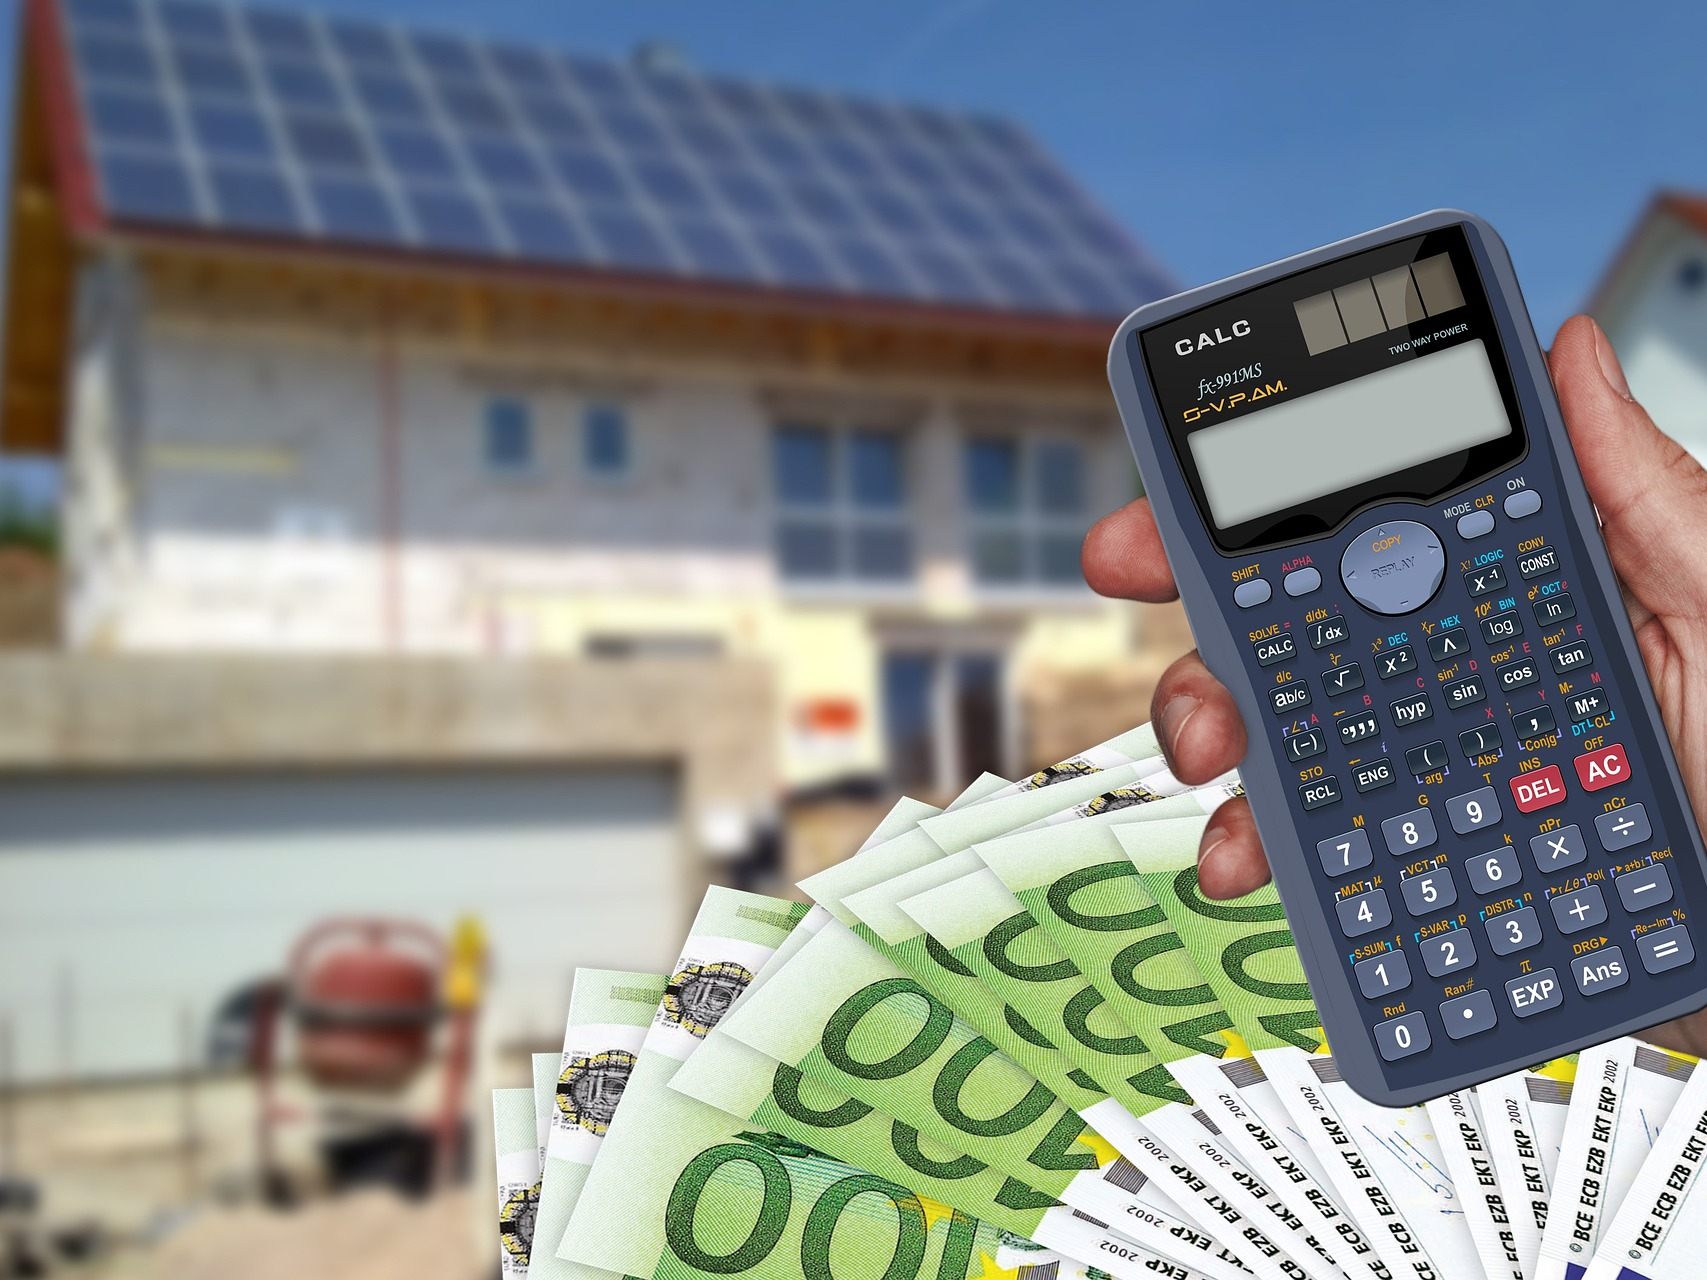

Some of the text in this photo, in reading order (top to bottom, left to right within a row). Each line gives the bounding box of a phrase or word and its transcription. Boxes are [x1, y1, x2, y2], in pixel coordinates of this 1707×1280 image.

[1175, 319, 1251, 356] CALC
[1389, 323, 1468, 356] TWO WAY POWER
[1197, 363, 1262, 400] fx-991MS
[1507, 477, 1526, 490] ON
[1444, 495, 1494, 518] MODE CLR
[1372, 534, 1401, 552] COPY
[1518, 536, 1544, 552] CONV
[1282, 556, 1313, 572] ALPHA
[1371, 556, 1415, 579] REPLAY
[1474, 549, 1504, 566] LOGIC
[1520, 552, 1556, 574] CONST
[1232, 564, 1260, 582] SHIFT
[1542, 581, 1560, 596] OCT
[1498, 597, 1516, 610] BIN
[1306, 609, 1328, 622] d/dx
[1440, 615, 1460, 628] HEX
[1250, 624, 1280, 642] SOLVE
[1490, 620, 1514, 636] log
[1576, 624, 1582, 636] F
[1388, 632, 1408, 646] DEC
[1522, 642, 1531, 653] E
[1258, 640, 1293, 660] CALC
[1558, 649, 1584, 665] tan
[1469, 660, 1478, 670] D
[1504, 666, 1532, 684] cos
[1276, 671, 1292, 684] d/c
[1416, 678, 1424, 688] C
[1590, 672, 1601, 684] M
[1274, 688, 1306, 706] ab/c
[1363, 694, 1372, 705] B
[1453, 684, 1478, 700] sin
[1538, 690, 1546, 700] Y
[1396, 702, 1426, 720] hyp
[1486, 707, 1494, 718] X
[1574, 696, 1598, 714] M+
[1310, 714, 1319, 724] A
[1525, 734, 1557, 751] Conjg
[1584, 736, 1604, 750] OFF
[1478, 754, 1498, 768] Abs
[1520, 758, 1541, 772] INS
[1588, 754, 1621, 782] AC
[1300, 766, 1323, 781] STO
[1358, 766, 1388, 786] ENG
[1426, 771, 1443, 784] arg
[1483, 774, 1491, 784] T
[1306, 784, 1335, 802] RCL
[1418, 794, 1428, 805] G
[1517, 778, 1560, 803] DEL
[1466, 801, 1483, 823] 9
[1604, 796, 1626, 812] nCr
[1353, 815, 1364, 827] M
[1539, 818, 1561, 832] nPr
[1402, 822, 1419, 845] 8
[1504, 834, 1512, 844] k
[1336, 842, 1350, 866] 7
[1406, 854, 1448, 876] VCT m
[1486, 858, 1502, 881] 6
[1340, 880, 1364, 898] MAT
[1421, 879, 1437, 902] 5
[1357, 900, 1372, 923] 4
[1485, 892, 1532, 916] DISTR n
[1672, 908, 1686, 921] %
[1420, 913, 1467, 938] S-VAR p
[1506, 920, 1522, 944] 3
[1354, 940, 1386, 960] S-SUM
[1440, 942, 1459, 966] 2
[1573, 938, 1600, 955] DRG
[1374, 964, 1390, 986] 1
[1582, 960, 1622, 985] Ans
[1444, 978, 1474, 997] Ran#
[1511, 978, 1554, 1008] EXP
[1384, 1002, 1406, 1018] Rnd
[1395, 1025, 1411, 1048] 0
[1218, 1094, 1246, 1119] 2002
[1300, 1086, 1324, 1112] 2002
[1506, 1099, 1522, 1124] 2002
[1246, 1123, 1278, 1150] EKP
[1320, 1116, 1349, 1145] EKP
[1460, 1122, 1482, 1152] EKP
[1138, 1136, 1170, 1161] 2002
[1514, 1130, 1534, 1158] EKP
[1574, 1060, 1618, 1242] BCE ECB EZB EKT EKP 2002
[1198, 1142, 1231, 1168] 2002
[1341, 1150, 1371, 1179] EKT
[1170, 1164, 1207, 1192] EKP
[1273, 1156, 1308, 1184] EKT
[1472, 1158, 1496, 1186] EKT
[1522, 1164, 1543, 1192] EKT
[1232, 1172, 1268, 1200] EKP
[1636, 1222, 1662, 1250] BCE
[1652, 1192, 1677, 1220] ECB
[1666, 1164, 1692, 1191] EZB
[1682, 1136, 1706, 1162] EKT
[1204, 1196, 1242, 1224] EKT
[1305, 1189, 1339, 1218] EZB
[1366, 1186, 1395, 1216] EZB
[1486, 1194, 1510, 1224] EZB
[1266, 1202, 1304, 1230] EKT
[1126, 1205, 1212, 1251] EKP 2002
[1336, 1223, 1372, 1254] ECB
[1388, 1222, 1420, 1254] ECB
[1242, 1227, 1280, 1258] EZB
[1100, 1240, 1188, 1280] EKP 2002
